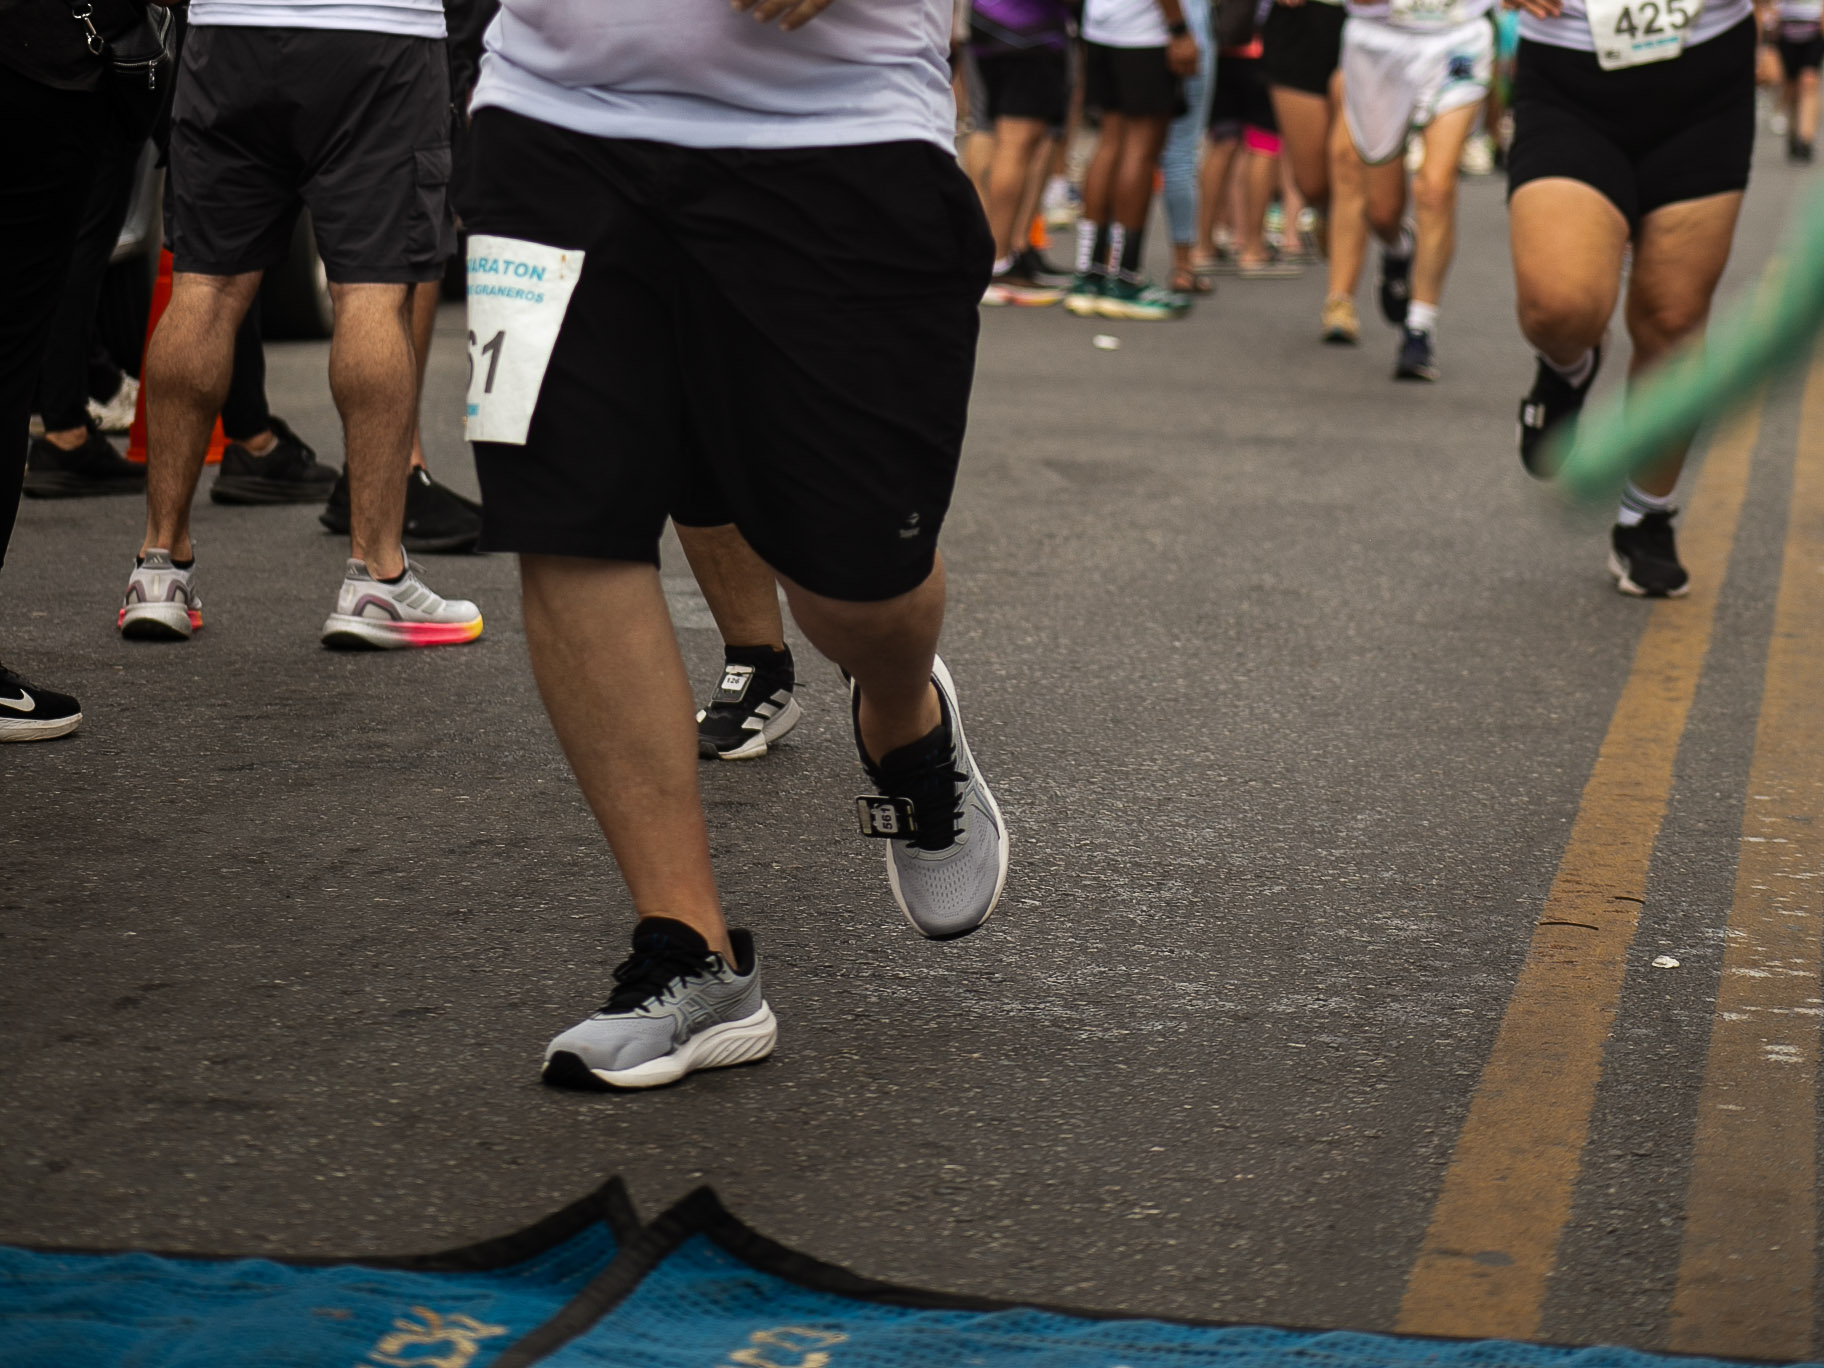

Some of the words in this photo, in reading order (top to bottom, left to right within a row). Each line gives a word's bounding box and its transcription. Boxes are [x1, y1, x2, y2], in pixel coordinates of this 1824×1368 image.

[468, 256, 547, 282] ARATON
[474, 283, 545, 304] GRANEROS
[880, 807, 894, 831] 561
